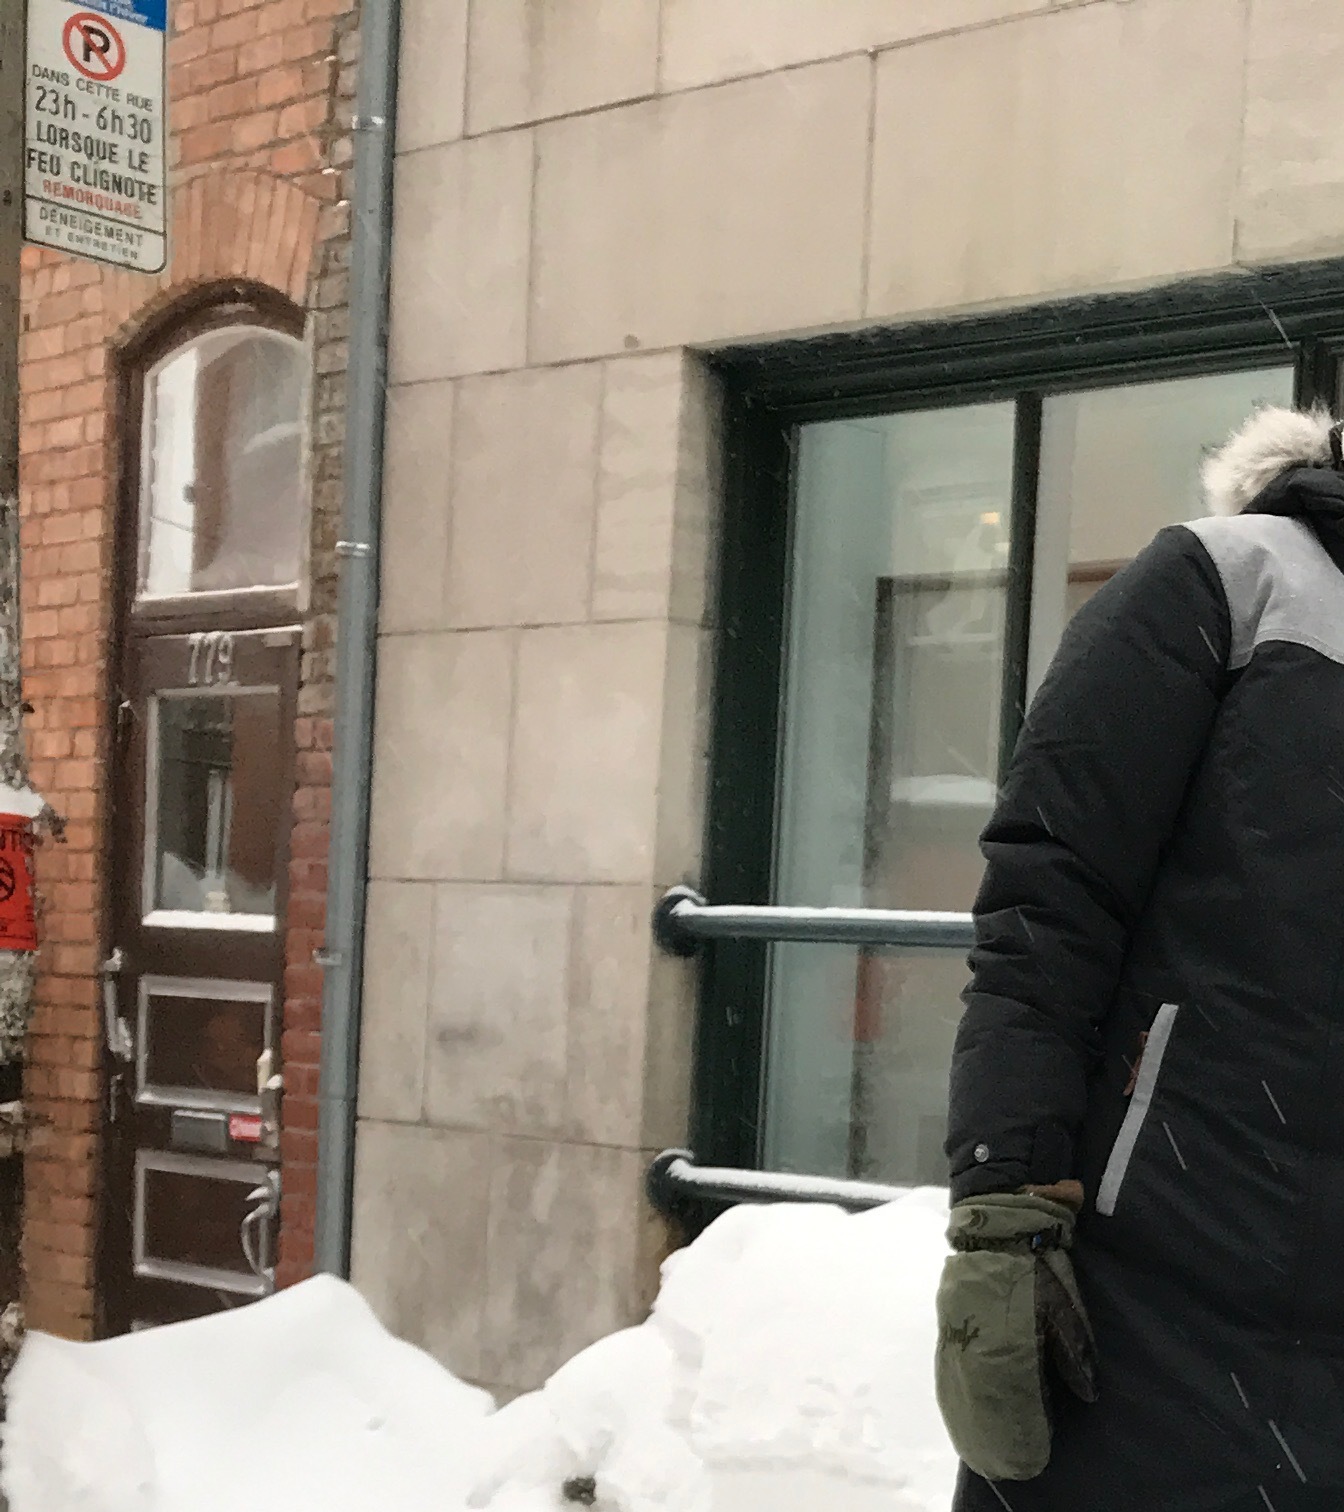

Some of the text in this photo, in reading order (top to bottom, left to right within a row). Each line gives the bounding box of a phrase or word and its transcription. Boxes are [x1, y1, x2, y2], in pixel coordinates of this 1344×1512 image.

[32, 64, 153, 112] DANS CETTE RUE
[35, 86, 75, 120] 23h
[96, 106, 151, 144] 6h30
[36, 120, 149, 173] LORSQUE LE
[26, 147, 157, 205] FEU CLIGNOTE
[42, 179, 142, 219] REMORQUAGE
[187, 633, 234, 684] 779
